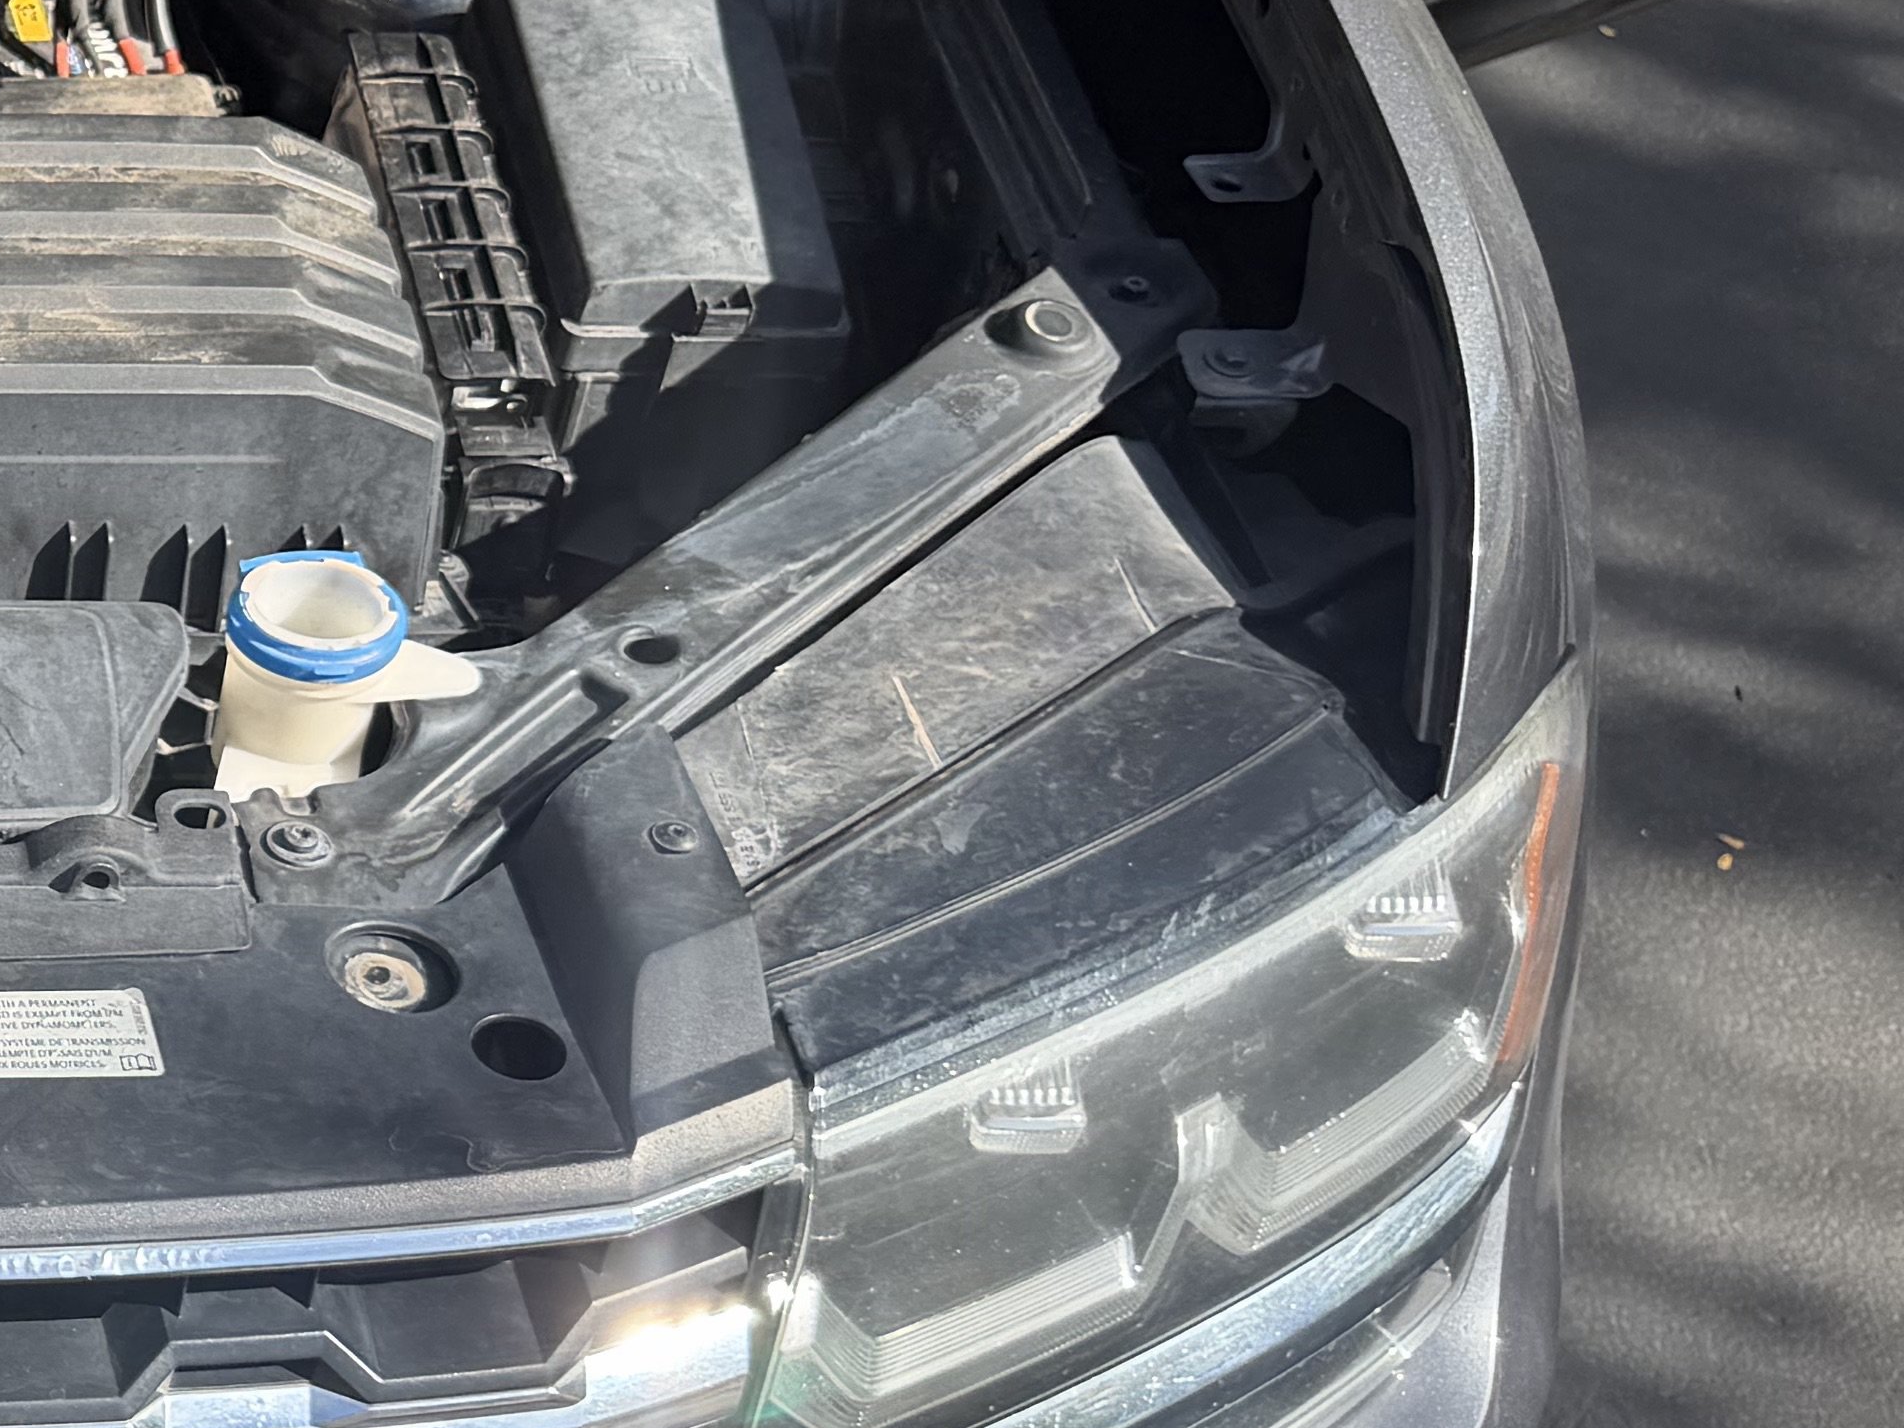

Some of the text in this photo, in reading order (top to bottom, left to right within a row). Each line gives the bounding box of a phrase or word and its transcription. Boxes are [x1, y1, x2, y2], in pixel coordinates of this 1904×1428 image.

[28, 999, 96, 1008] PERMANENT
[25, 1010, 68, 1019] EXEMPT
[70, 1009, 103, 1018] FROM
[0, 1038, 46, 1047] SYSTÈME
[48, 1038, 64, 1047] DE
[66, 1037, 146, 1046] TRANSMISSION
[11, 1060, 48, 1069] ROUES
